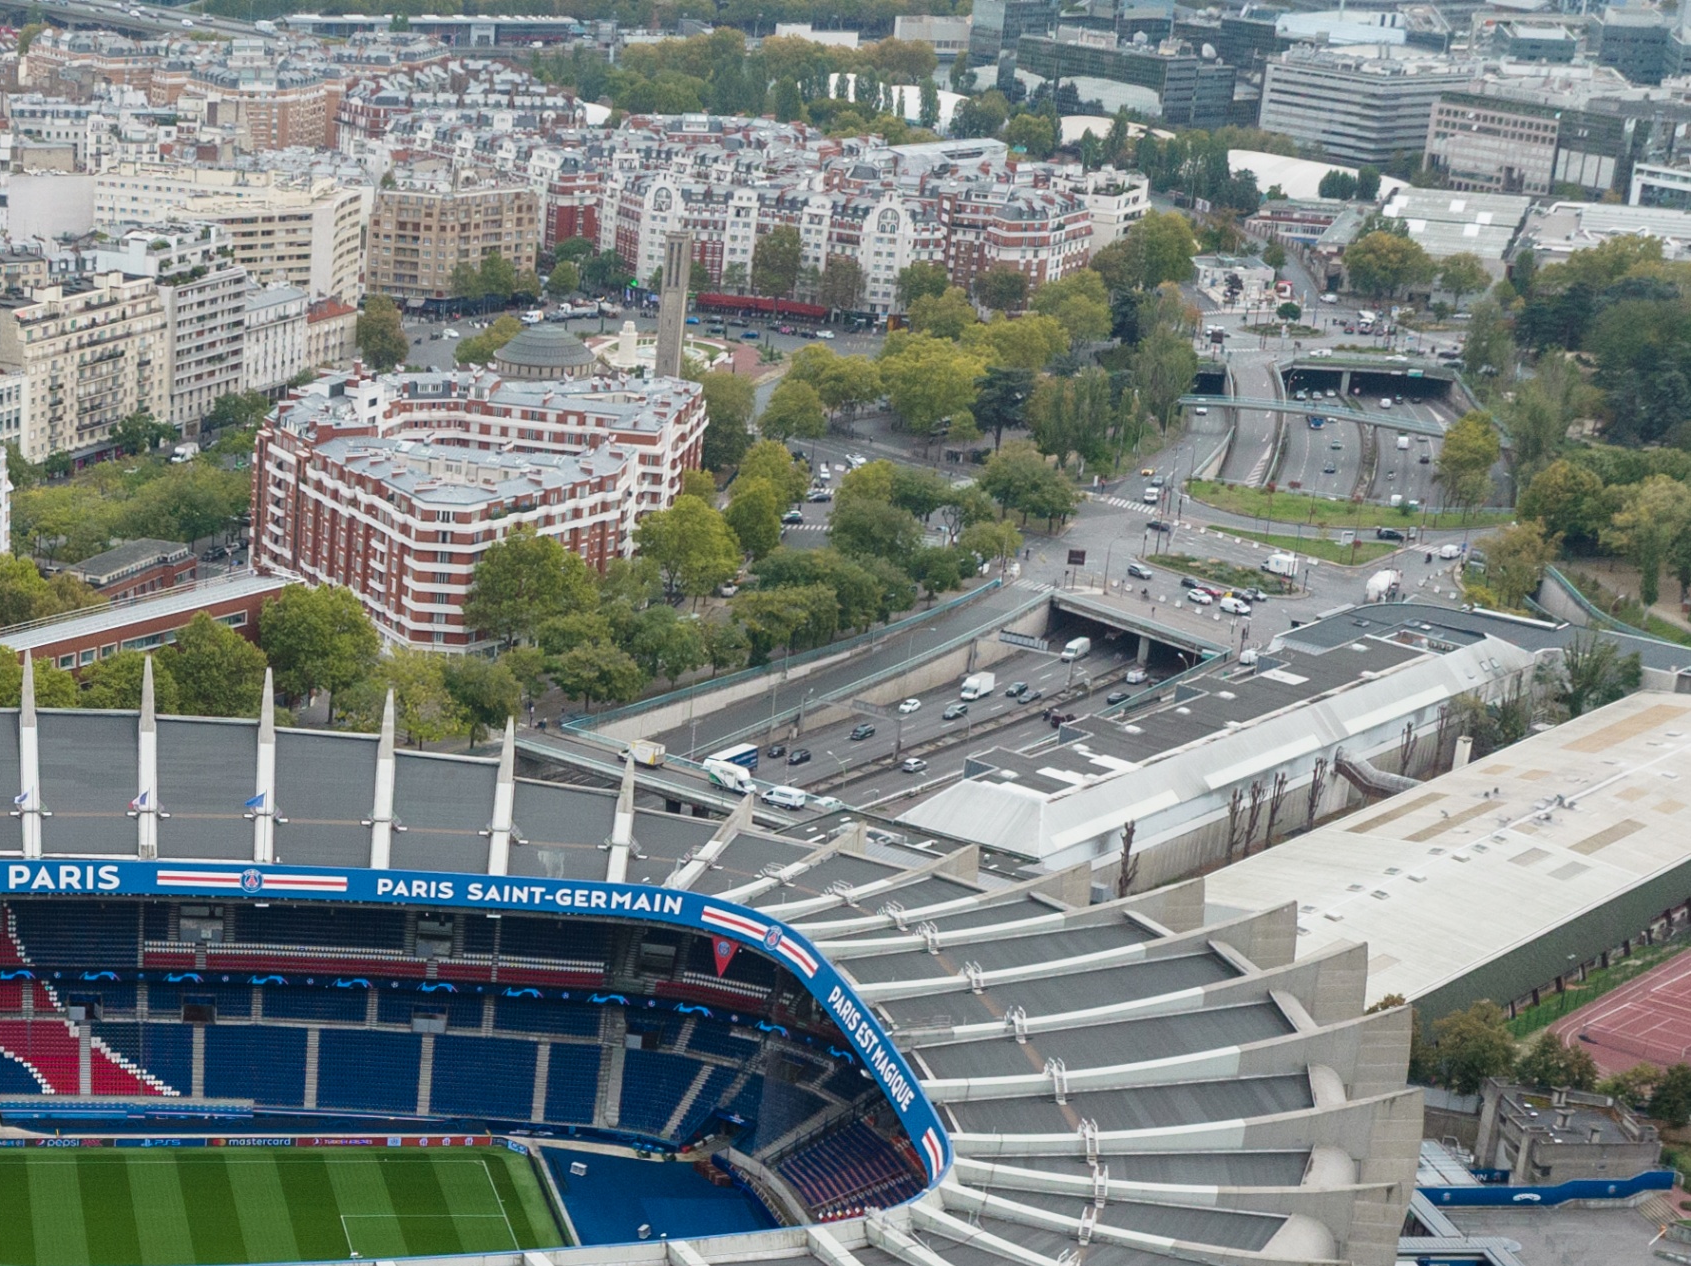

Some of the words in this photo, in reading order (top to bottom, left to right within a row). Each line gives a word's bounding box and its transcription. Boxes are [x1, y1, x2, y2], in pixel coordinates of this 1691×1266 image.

[8, 864, 120, 890] PARIS
[376, 878, 454, 899] PARIS
[467, 884, 684, 915] SAINT-GERMAIN
[827, 985, 861, 1032] PARIS
[854, 1021, 880, 1054] EST
[871, 1044, 915, 1113] MAGIQUE
[47, 1139, 80, 1148] pepsi
[228, 1137, 291, 1147] mastercard
